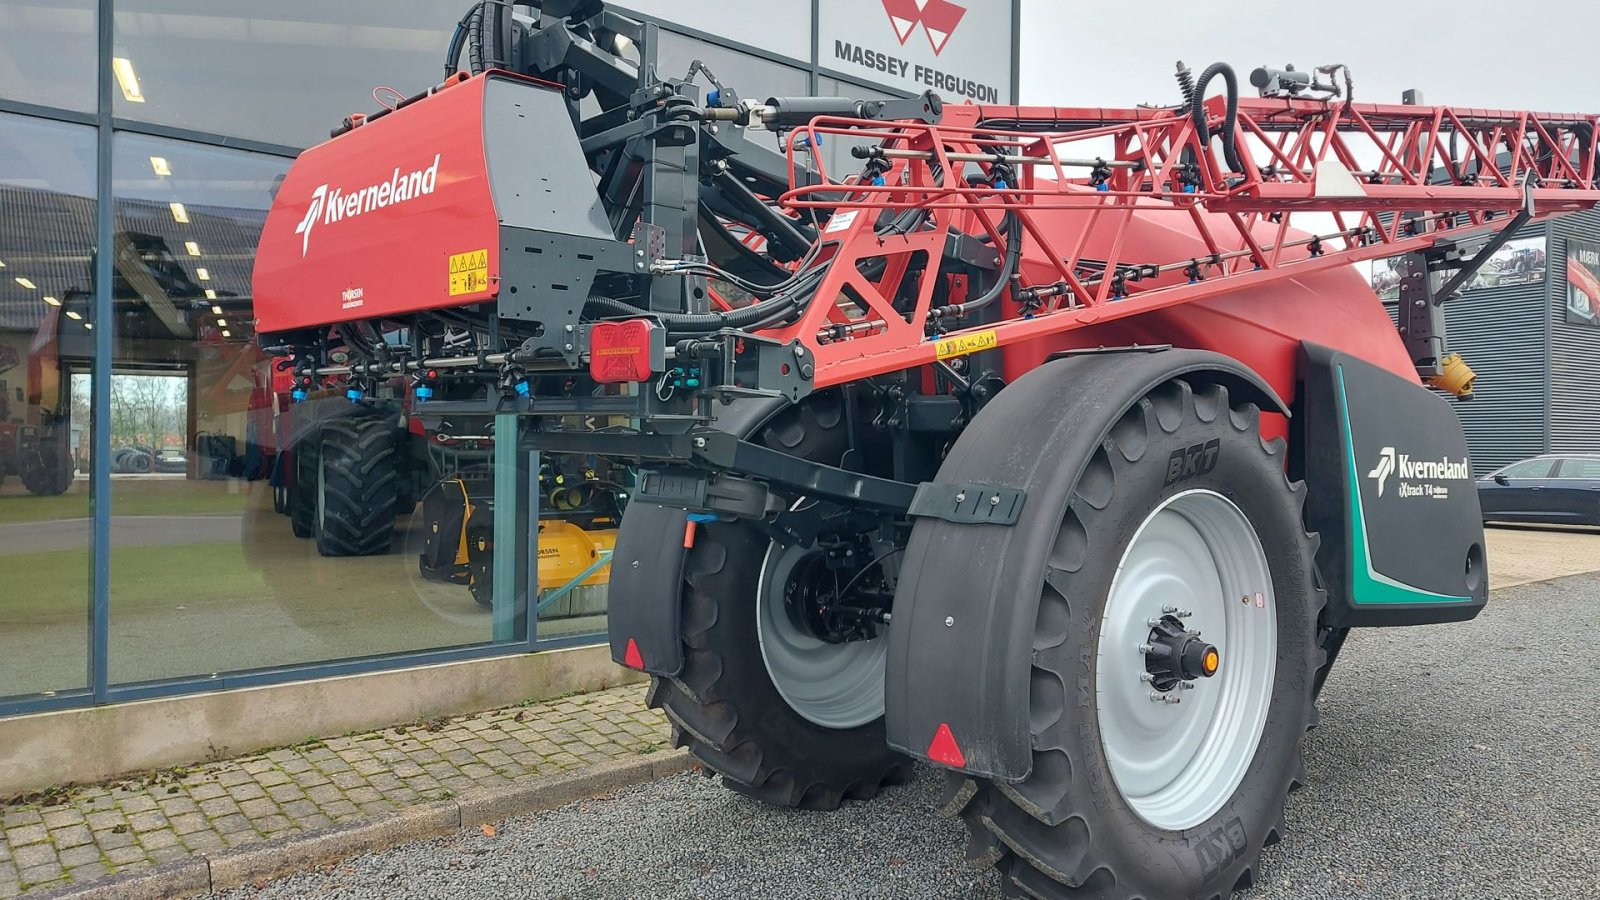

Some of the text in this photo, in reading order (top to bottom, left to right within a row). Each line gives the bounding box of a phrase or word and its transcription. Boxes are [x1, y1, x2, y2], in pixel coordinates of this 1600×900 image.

[835, 39, 998, 104] MASSEY FERGUSON
[324, 153, 441, 225] Kverneland
[1166, 441, 1219, 483] BKT
[1398, 454, 1469, 480] Kverneland
[1398, 482, 1424, 498] iXtrack
[1424, 484, 1433, 496] T4
[1198, 819, 1244, 878] BKT
